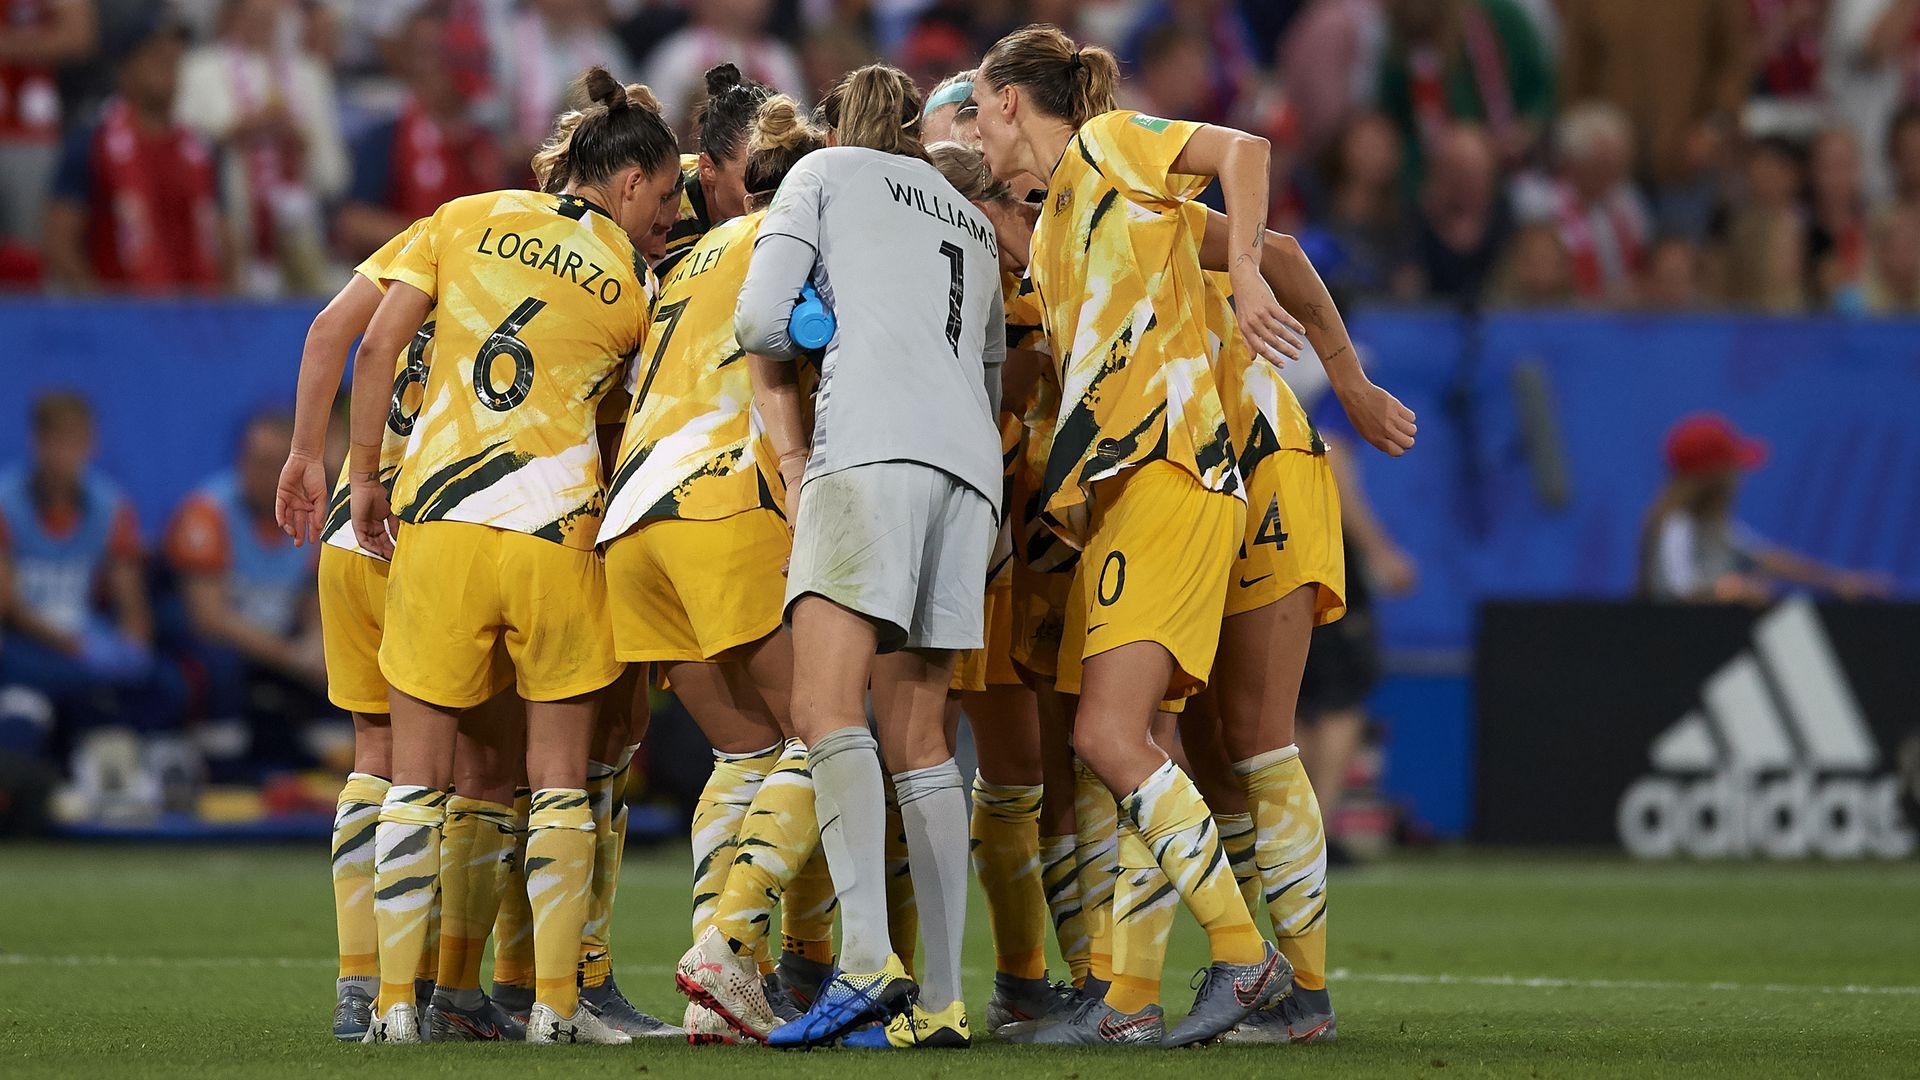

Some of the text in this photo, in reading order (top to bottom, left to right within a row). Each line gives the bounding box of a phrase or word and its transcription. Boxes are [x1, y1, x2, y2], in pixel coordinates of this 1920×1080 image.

[884, 176, 997, 259] WILLIAMS
[477, 227, 622, 305] LOGARZO
[938, 239, 964, 359] 1
[472, 296, 547, 412] 6
[633, 295, 692, 414] 7
[1238, 492, 1288, 559] 4
[1091, 551, 1126, 612] 0
[1617, 773, 1911, 859] adidas
